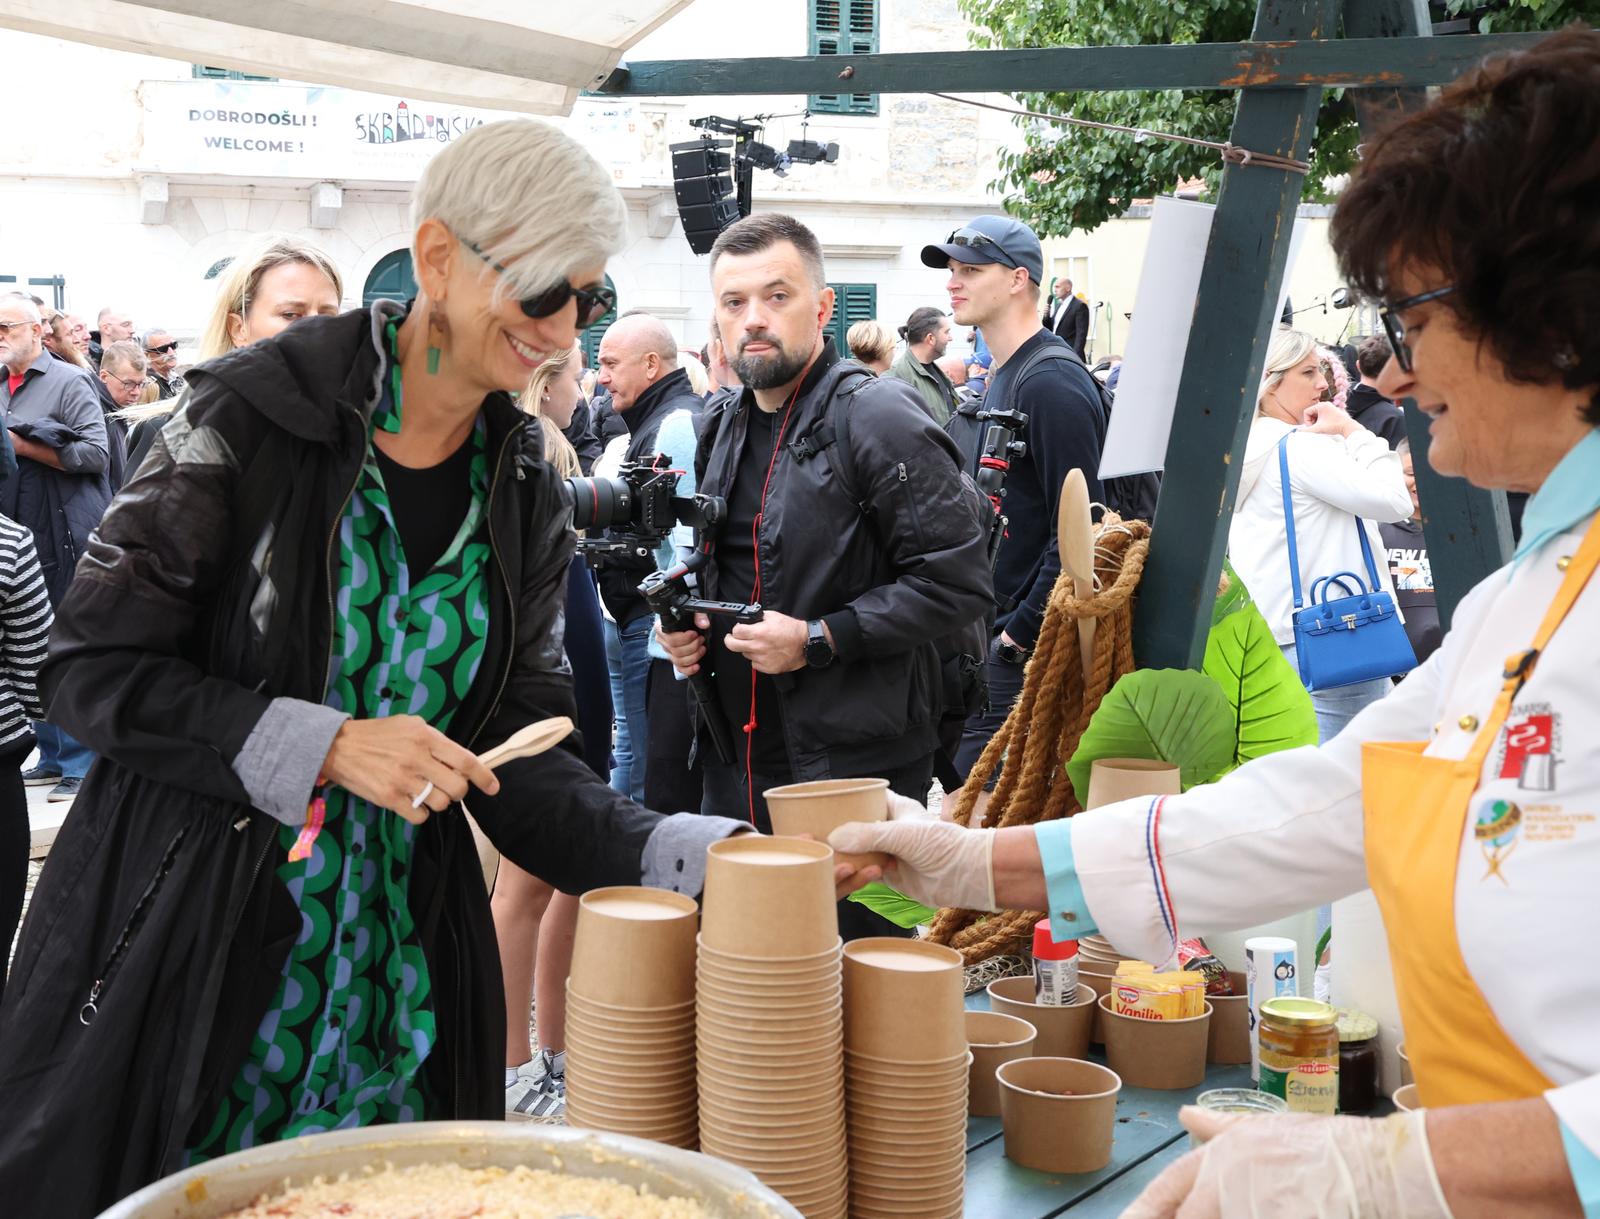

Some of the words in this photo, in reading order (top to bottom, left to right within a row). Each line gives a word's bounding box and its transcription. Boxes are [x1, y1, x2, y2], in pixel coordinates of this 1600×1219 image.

[189, 109, 306, 126] DOBRODOŠLI
[355, 101, 481, 144] SKRADINSK
[204, 137, 294, 152] WELCOME
[1116, 1002, 1163, 1020] Vanilin
